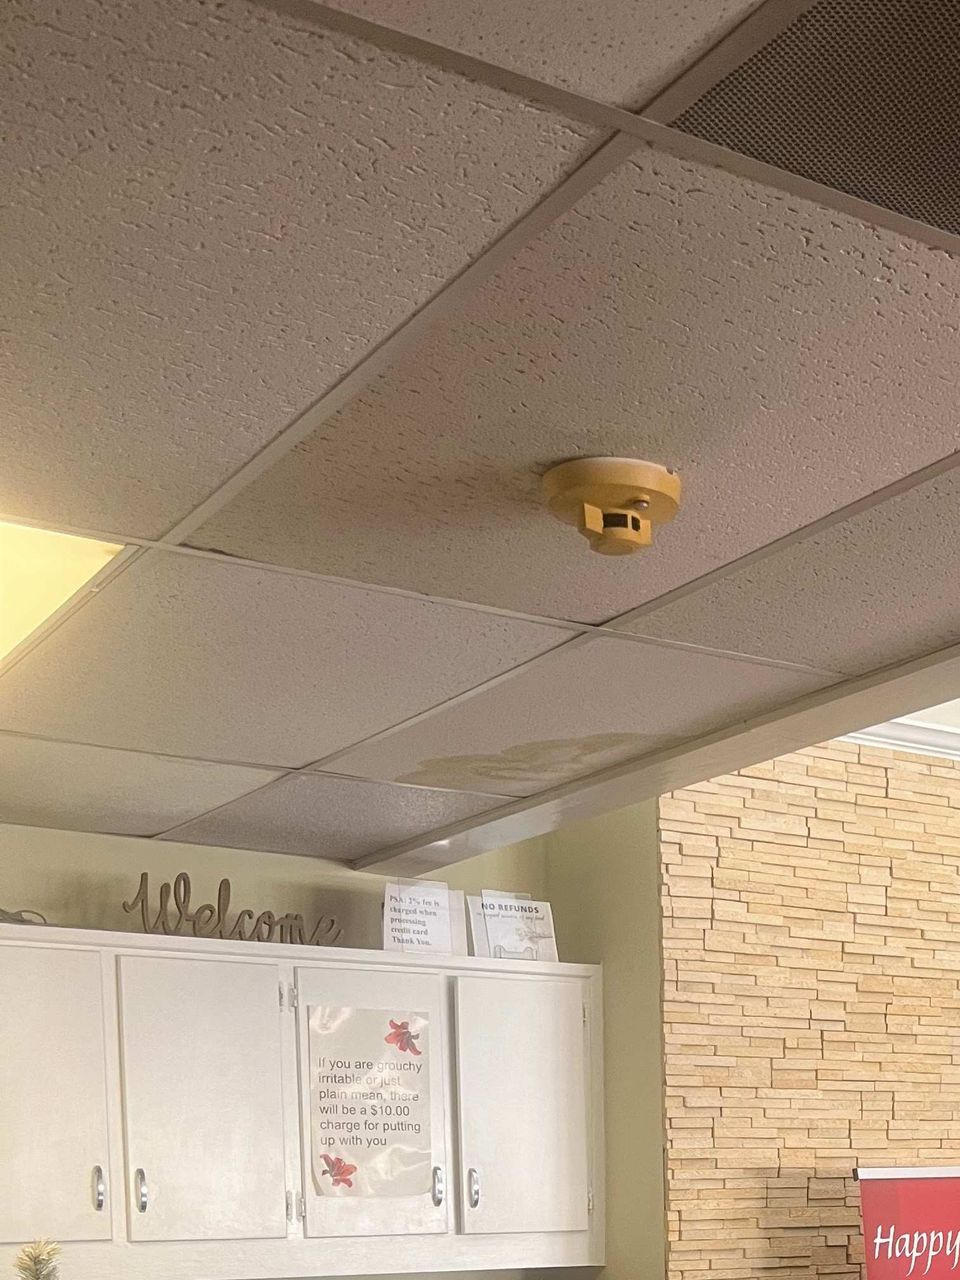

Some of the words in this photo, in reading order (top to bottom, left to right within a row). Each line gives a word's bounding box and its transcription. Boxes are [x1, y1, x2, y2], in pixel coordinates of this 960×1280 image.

[123, 872, 343, 945] Welcome
[390, 906, 417, 915] charged
[419, 909, 437, 917] when
[482, 903, 495, 911] NO
[498, 904, 539, 914] REFUNDS
[390, 917, 426, 927] processing
[391, 927, 411, 935] credit
[392, 936, 414, 945] Thank
[318, 1057, 326, 1068] If
[330, 1060, 350, 1071] you
[355, 1060, 373, 1070] are
[377, 1061, 422, 1074] grouchy
[318, 1072, 362, 1084] irritable
[366, 1076, 378, 1085] or
[380, 1076, 401, 1088] just
[320, 1089, 348, 1100] plain
[351, 1090, 387, 1101] mean,
[390, 1092, 419, 1101] there
[320, 1104, 338, 1115] will
[342, 1104, 356, 1115] be
[360, 1107, 366, 1115] a
[370, 1104, 410, 1116] $10.00
[320, 1120, 360, 1132] charge
[364, 1120, 379, 1130] for
[383, 1121, 421, 1134] putting
[320, 1137, 336, 1147] up
[339, 1135, 362, 1146] with
[366, 1137, 387, 1148] you
